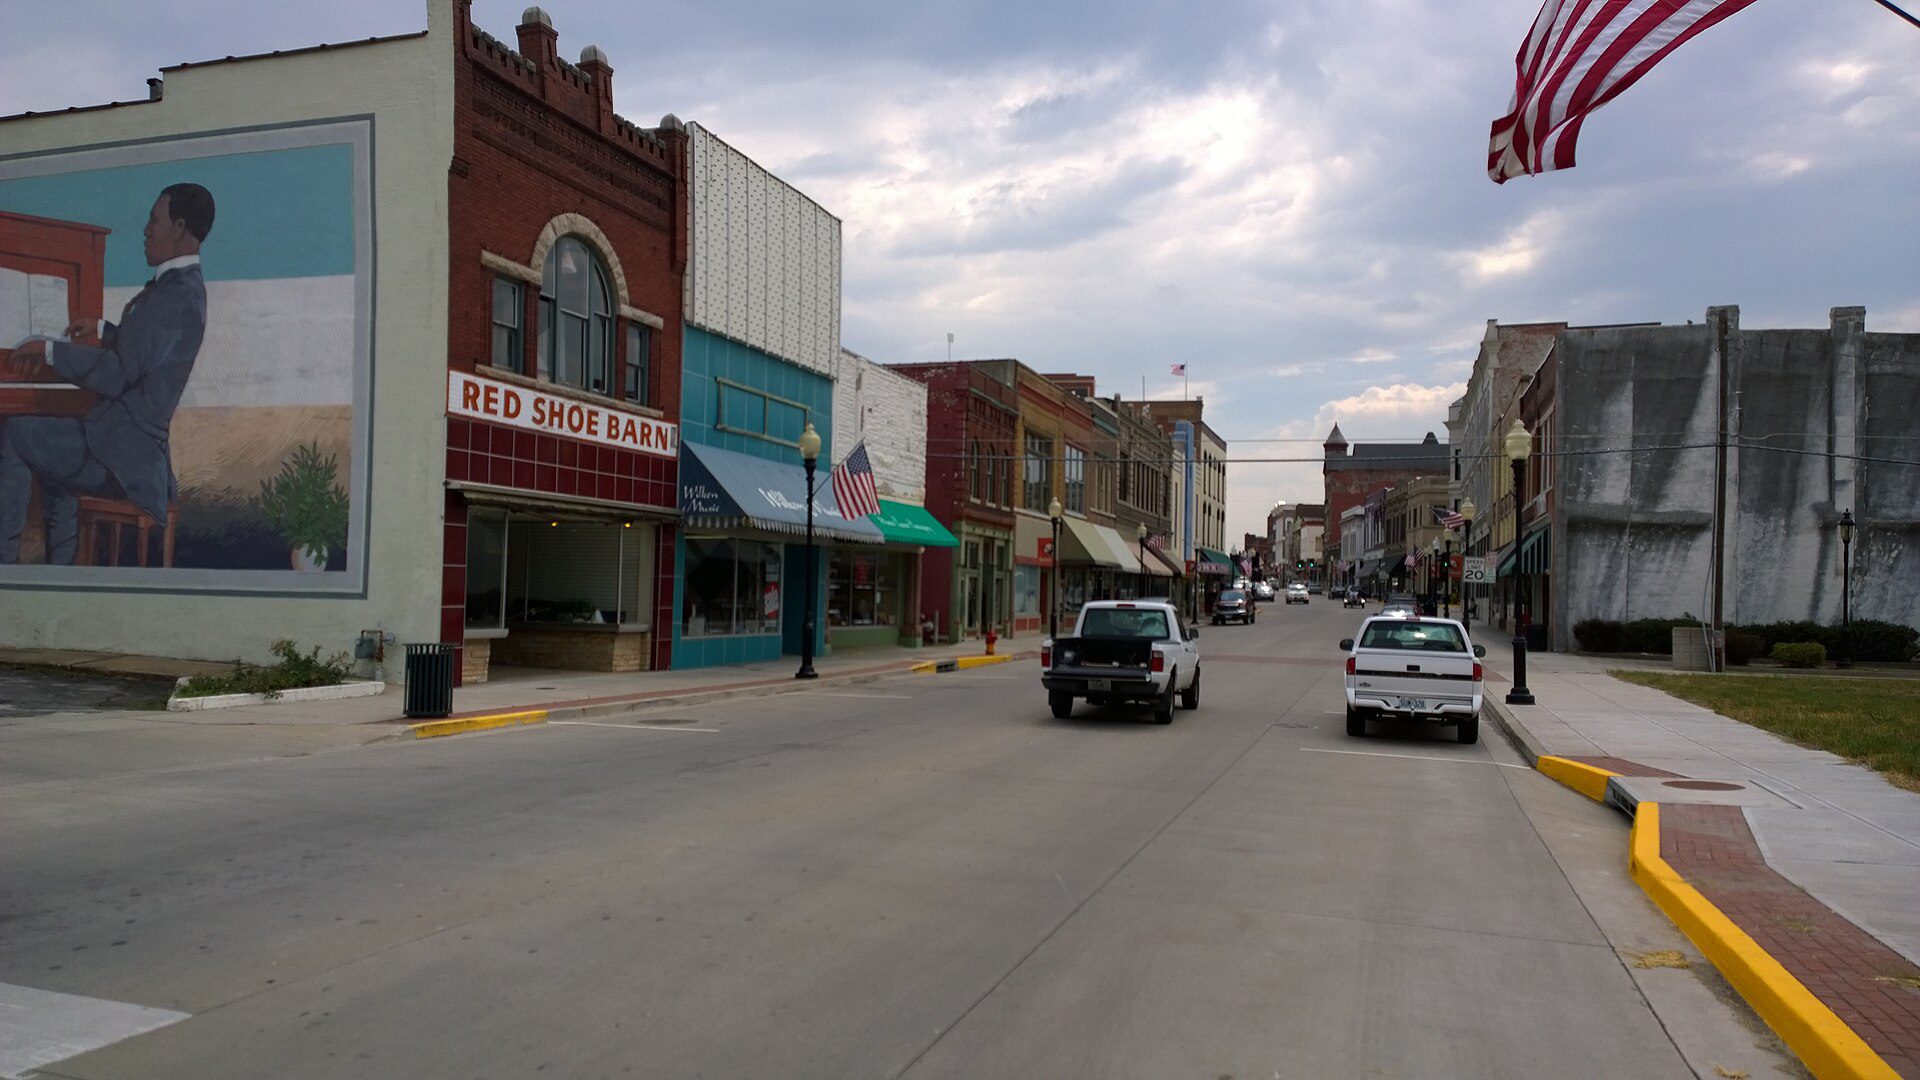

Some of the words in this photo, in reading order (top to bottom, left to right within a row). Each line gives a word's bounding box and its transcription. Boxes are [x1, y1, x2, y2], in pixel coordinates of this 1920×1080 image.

[462, 379, 521, 419] RED
[531, 396, 599, 436] SHOE
[606, 412, 669, 451] BARN
[684, 485, 718, 500] Wilken
[682, 498, 720, 513] Music
[1465, 570, 1484, 580] 20
